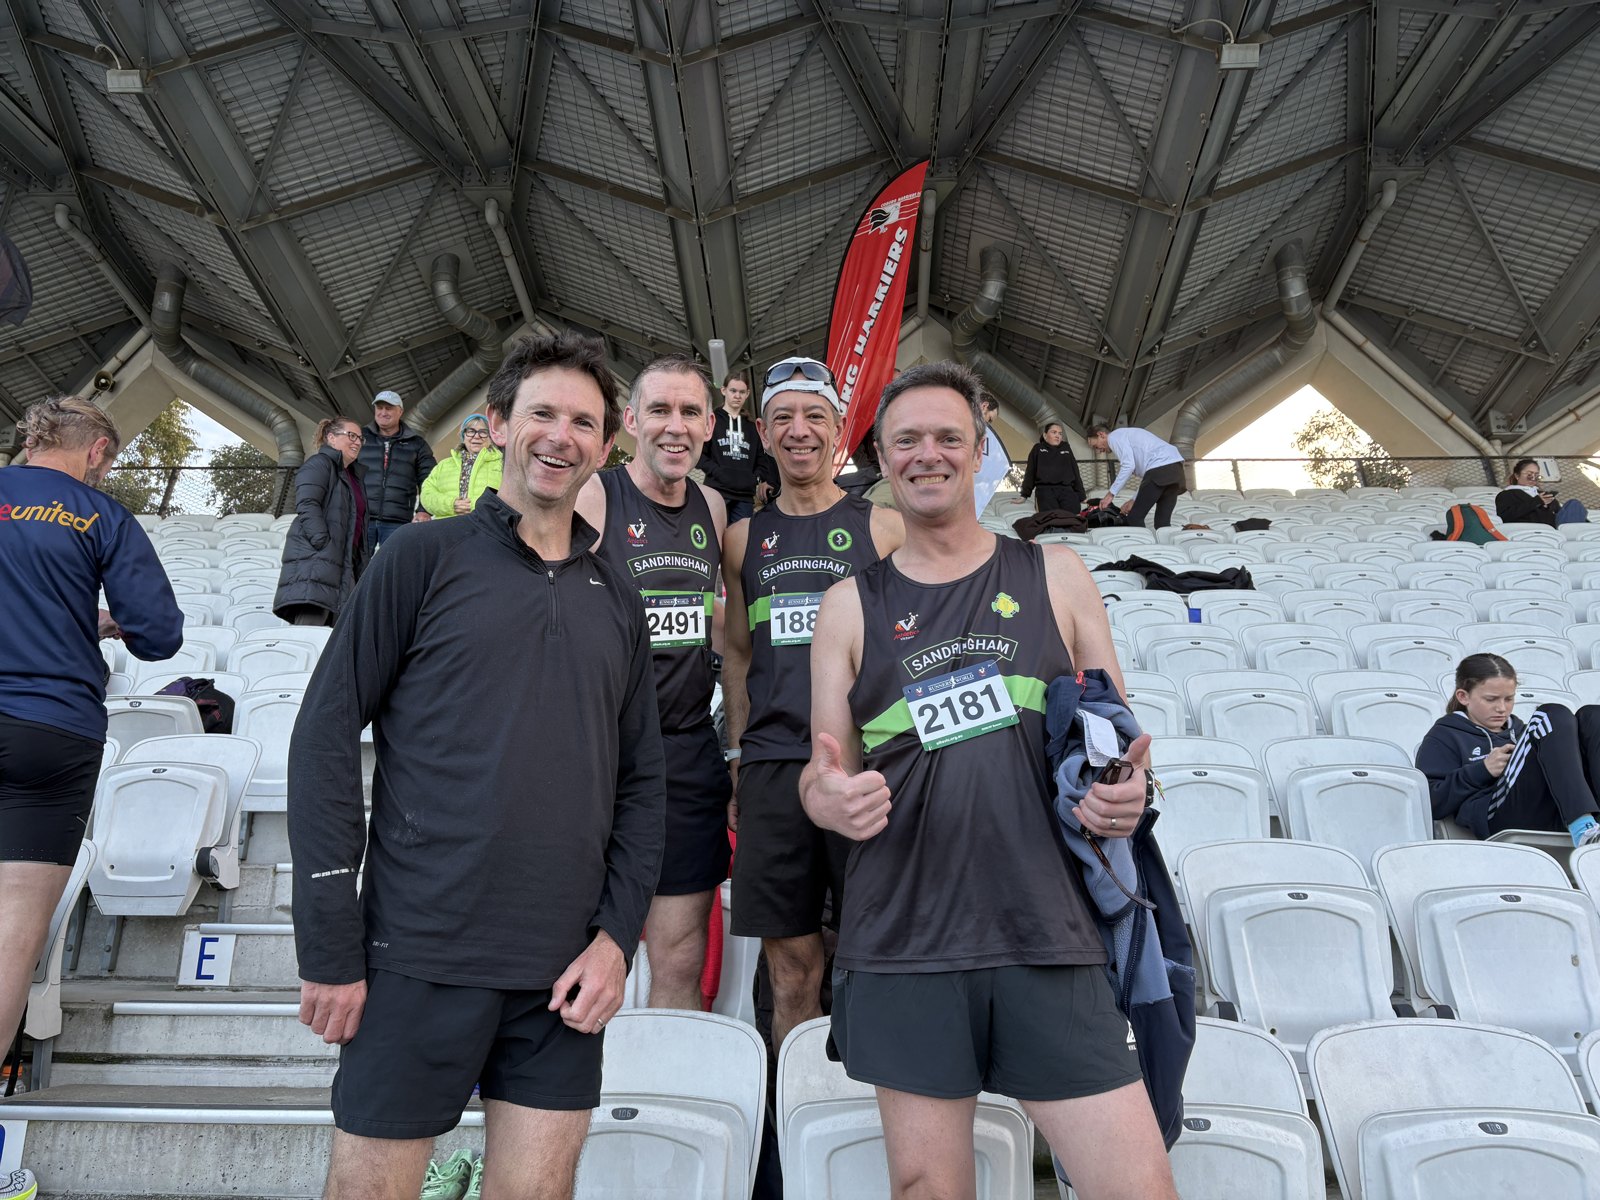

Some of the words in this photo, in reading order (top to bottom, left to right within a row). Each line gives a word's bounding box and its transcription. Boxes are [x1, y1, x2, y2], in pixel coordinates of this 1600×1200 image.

[853, 226, 908, 356] HARRIERS
[633, 555, 709, 575] SANDRINGHAM
[762, 559, 845, 580] SANDRINGHAM
[647, 611, 699, 636] 2491
[917, 683, 1002, 736] 2181
[195, 936, 219, 980] E
[618, 1109, 632, 1118] 106
